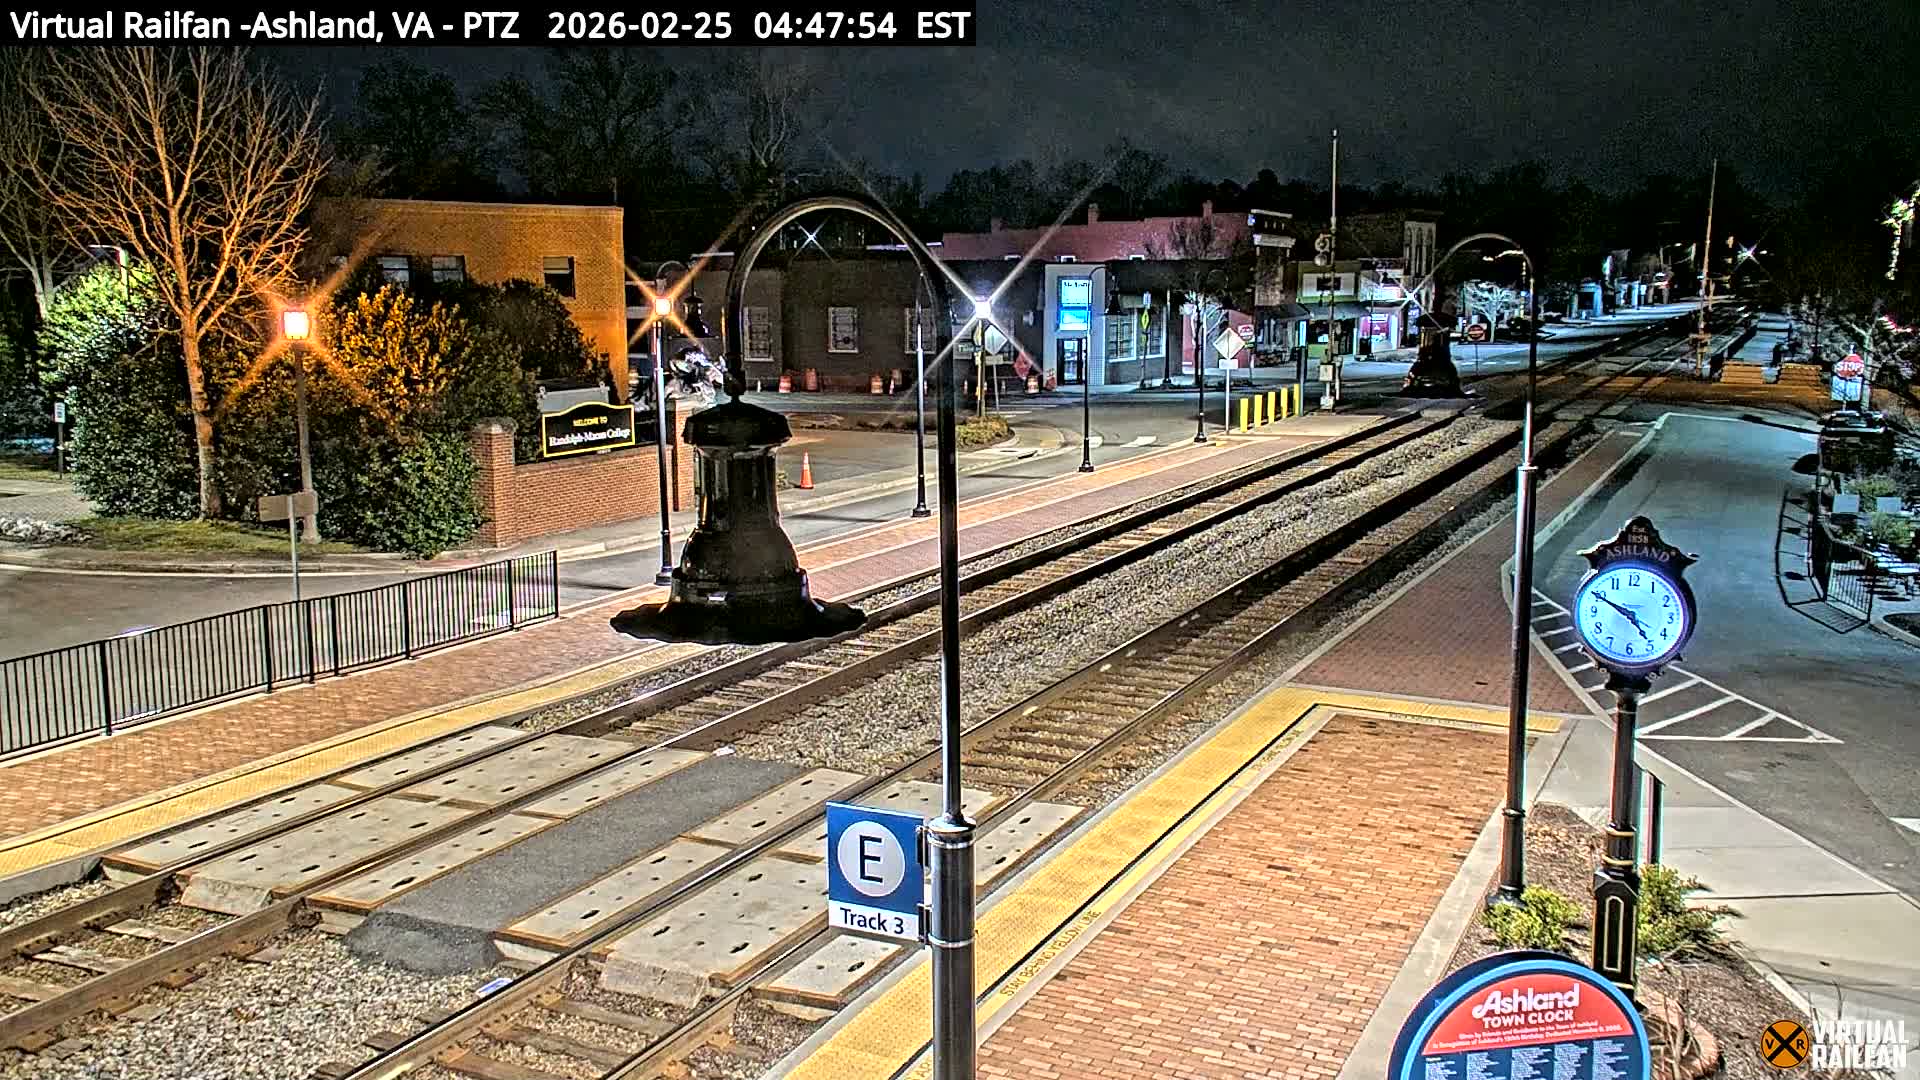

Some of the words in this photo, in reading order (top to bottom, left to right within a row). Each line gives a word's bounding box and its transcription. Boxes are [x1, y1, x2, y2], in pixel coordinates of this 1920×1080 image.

[1837, 362, 1862, 372] STOP
[607, 428, 631, 439] College
[1606, 545, 1670, 562] ASHLAND
[1611, 578, 1620, 590] 11
[1628, 574, 1641, 587] 12
[1651, 581, 1656, 593] 1
[1663, 595, 1671, 608] 2
[1591, 605, 1598, 618] 9
[1667, 612, 1675, 624] 3
[1594, 622, 1603, 634] 8
[1660, 627, 1667, 640] 4
[1605, 636, 1615, 650] 7
[1626, 642, 1633, 655] 6
[1645, 640, 1655, 654] 5
[859, 835, 883, 884] E
[839, 907, 888, 932] Track
[894, 917, 905, 935] 3
[1472, 983, 1580, 1019] Ashland
[1483, 1014, 1525, 1029] TOWN
[1528, 1009, 1574, 1025] CLOCK
